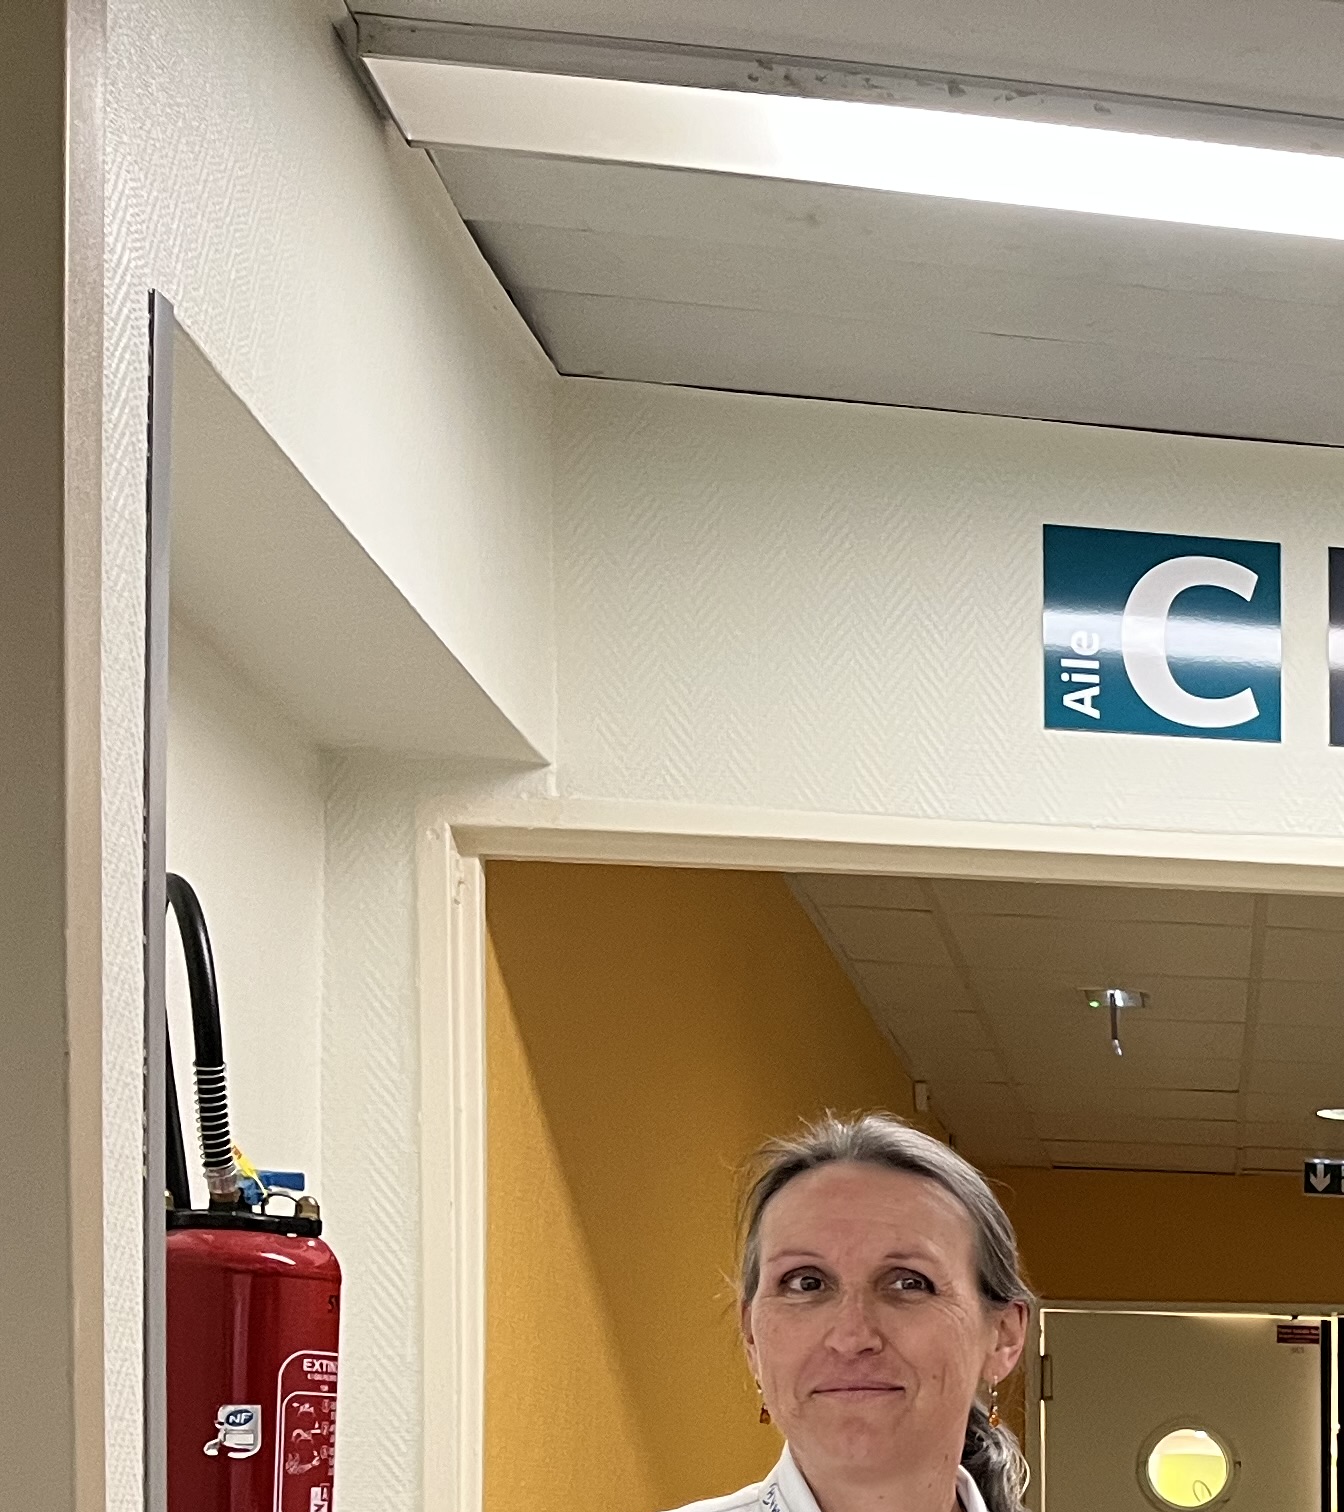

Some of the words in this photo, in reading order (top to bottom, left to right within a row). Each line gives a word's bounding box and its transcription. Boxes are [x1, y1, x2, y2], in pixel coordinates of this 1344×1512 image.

[1060, 629, 1101, 720] Aile
[1121, 555, 1260, 729] C
[228, 1412, 253, 1424] NF
